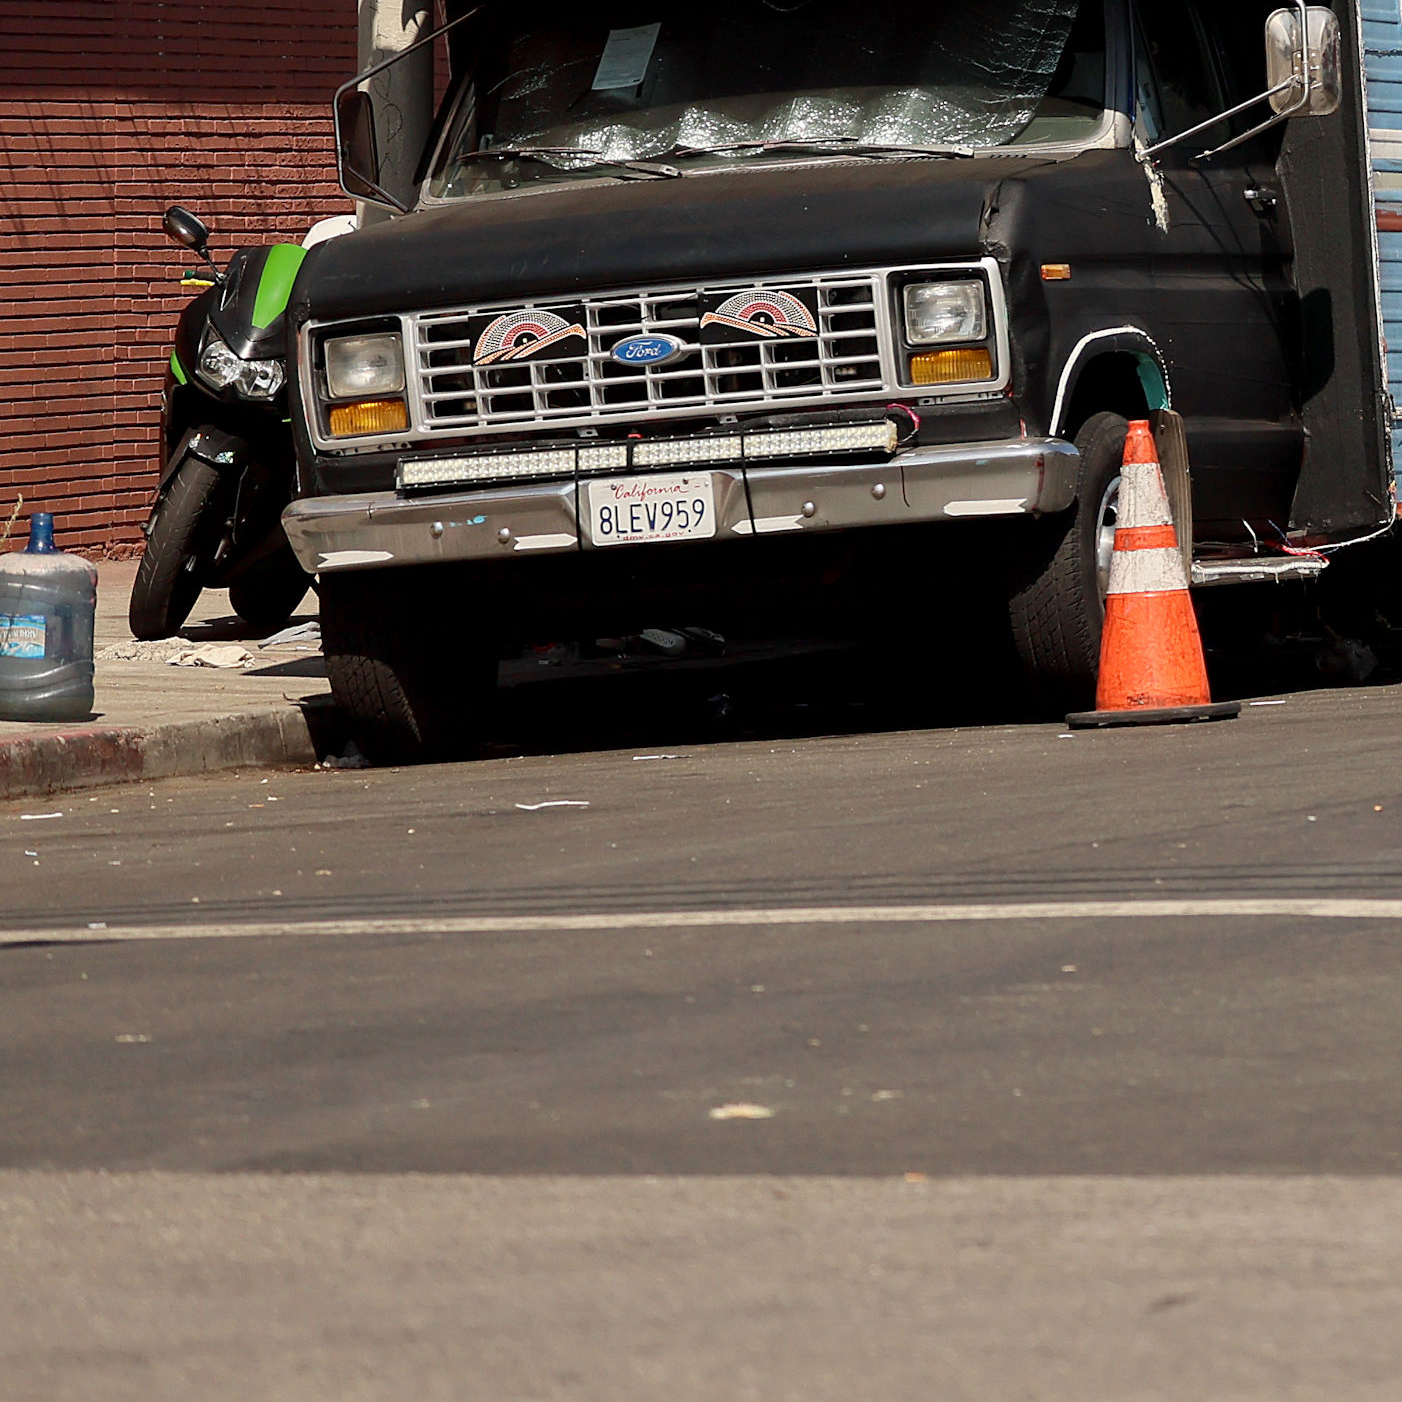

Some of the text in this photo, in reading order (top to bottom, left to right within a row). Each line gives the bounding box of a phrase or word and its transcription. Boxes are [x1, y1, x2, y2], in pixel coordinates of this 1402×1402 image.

[626, 341, 661, 359] Ford
[614, 482, 689, 502] California
[599, 499, 705, 535] 8LEV959
